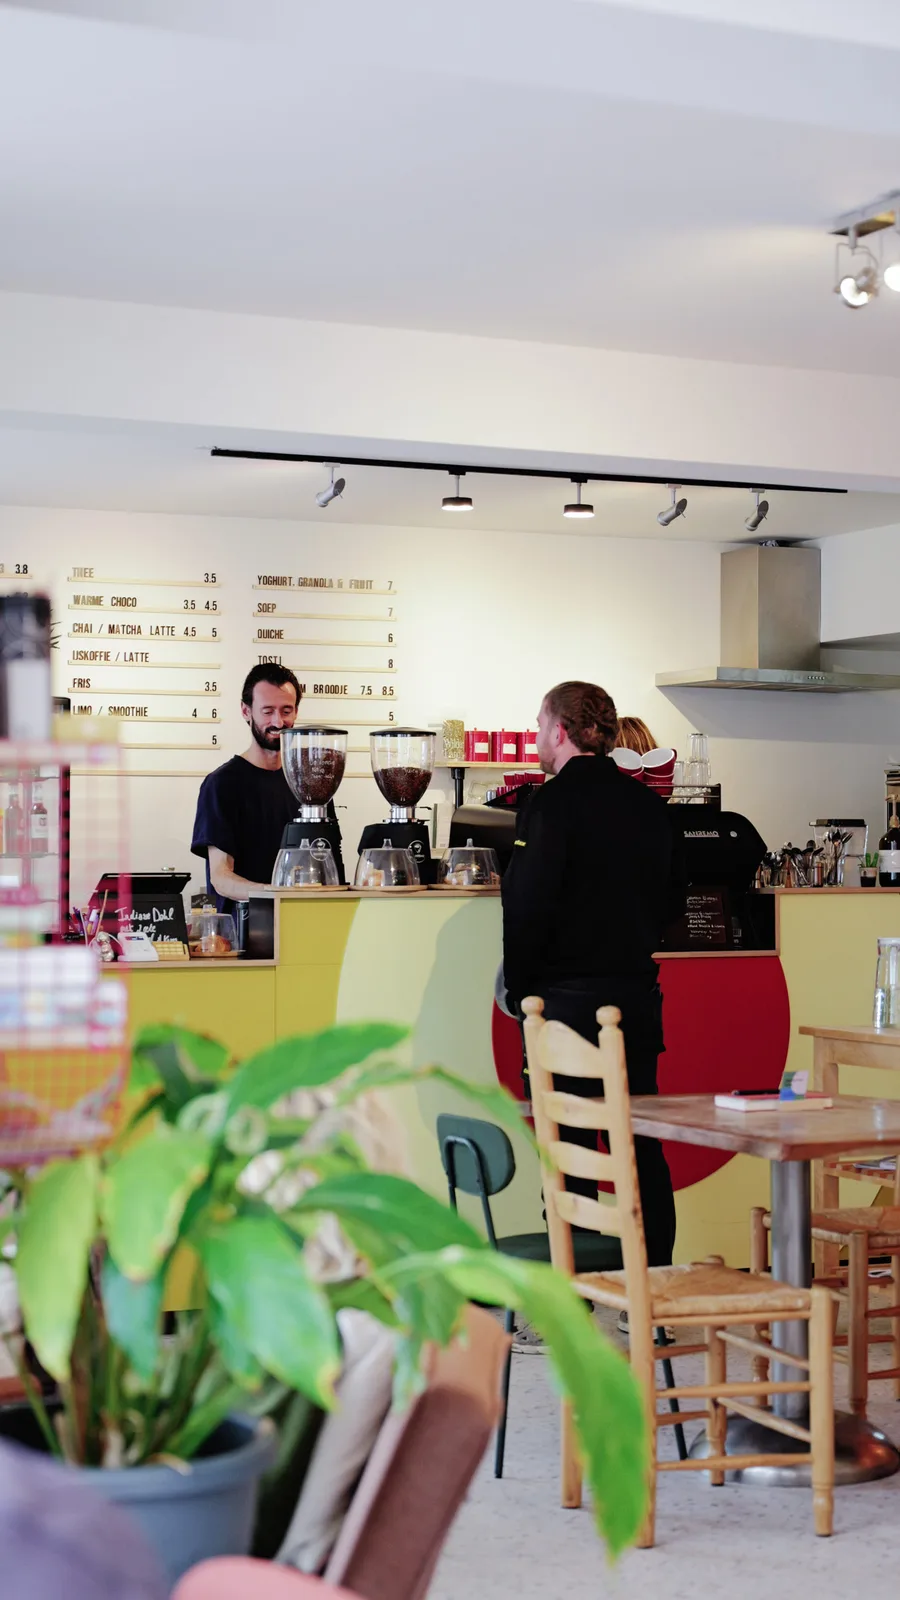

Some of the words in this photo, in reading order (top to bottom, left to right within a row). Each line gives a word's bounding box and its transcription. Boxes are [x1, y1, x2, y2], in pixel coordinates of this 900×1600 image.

[15, 563, 29, 575] 3.8
[72, 567, 95, 579] THEE
[204, 573, 217, 584] 3.5
[298, 577, 334, 589] GRANOLA
[349, 579, 374, 590] FRUIT
[387, 580, 394, 591] 7
[73, 595, 104, 607] WARME
[111, 596, 138, 608] CHOCO
[184, 599, 196, 610] 3.5
[204, 600, 218, 611] 4.5
[257, 602, 277, 614] SOEP
[388, 607, 394, 618] 7
[72, 622, 93, 634] CHAI
[108, 624, 142, 636] MATCHA
[150, 625, 176, 637] LATTE
[183, 626, 197, 637] 4.5
[212, 627, 218, 638] 5
[387, 633, 394, 643] 6
[124, 652, 150, 663] LATTE
[388, 659, 394, 669] 8
[72, 678, 91, 689] FRIS
[204, 682, 218, 692] 3.5
[313, 684, 348, 695] BROODJE
[360, 685, 373, 696] 7.5
[382, 686, 394, 696] 8.5
[72, 705, 93, 716] LIMO
[108, 706, 149, 718] SMOOTHIE
[192, 708, 198, 719] 4
[212, 708, 218, 719] 6
[388, 711, 394, 722] 5
[212, 735, 218, 746] 5
